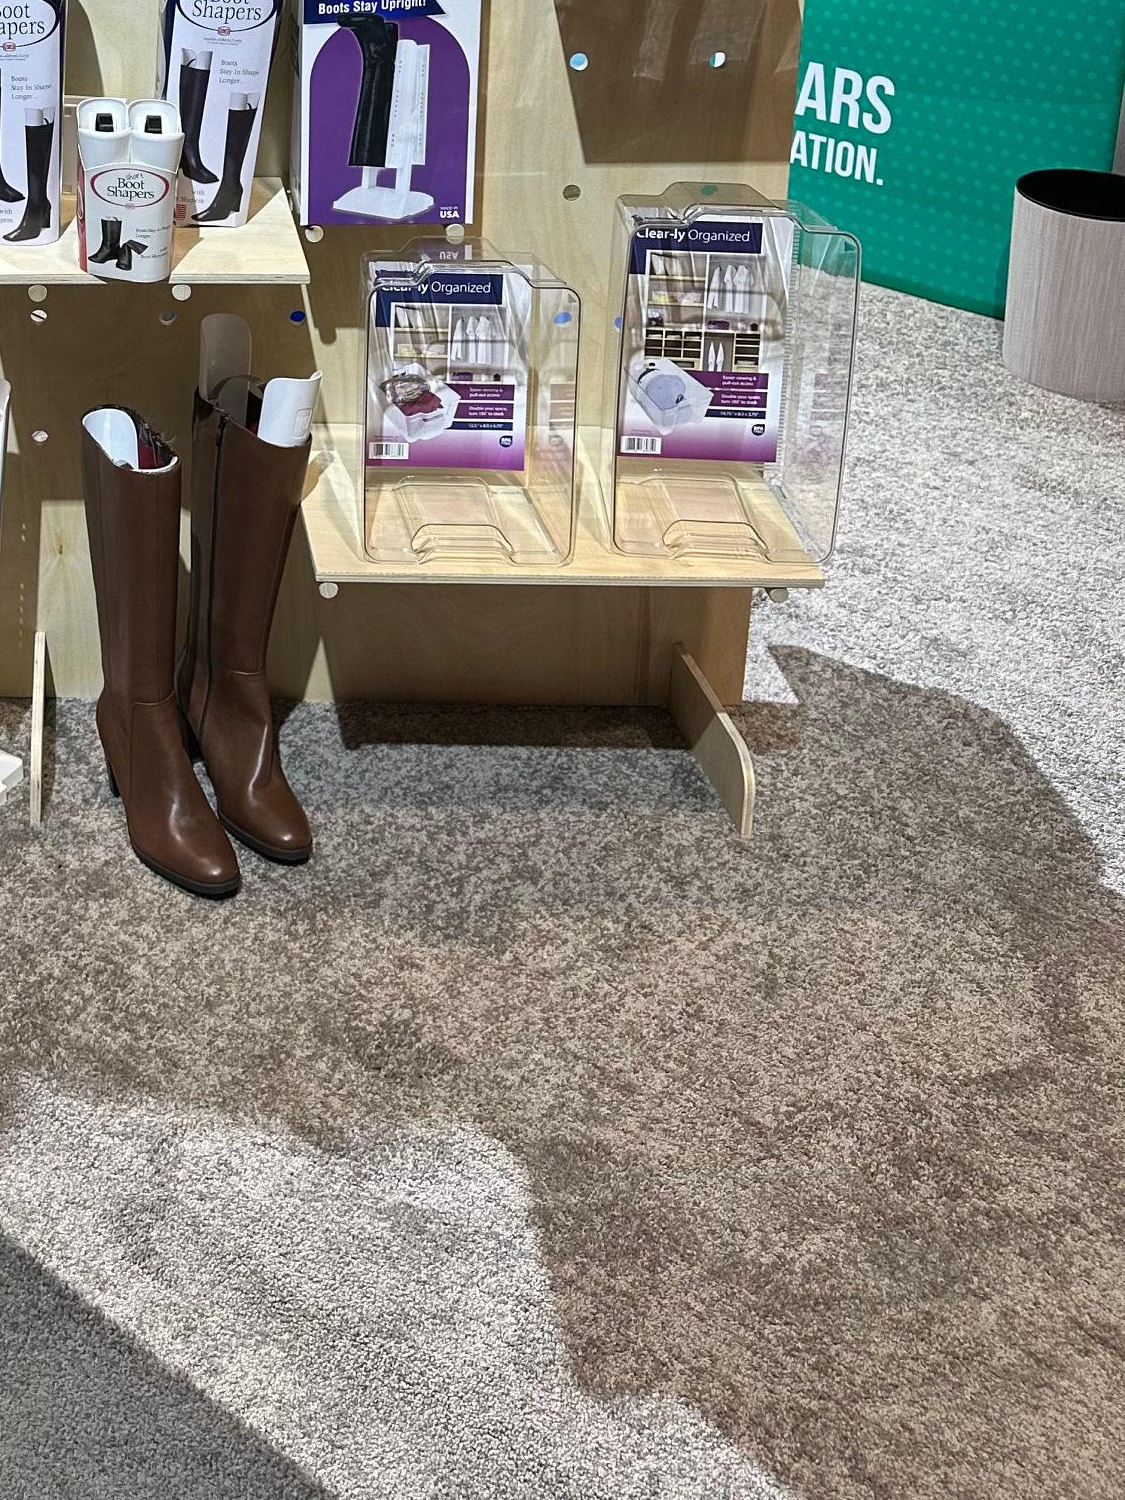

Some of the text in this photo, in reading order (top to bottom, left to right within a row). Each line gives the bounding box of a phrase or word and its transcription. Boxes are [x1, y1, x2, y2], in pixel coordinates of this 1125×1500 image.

[191, 0, 262, 24] Shapers
[318, 3, 350, 15] Boots
[353, 0, 378, 13] Stay
[117, 177, 145, 190] Boot
[107, 186, 154, 201] Shapers
[439, 210, 459, 219] USA
[688, 229, 750, 242] Organized
[431, 281, 491, 295] Organized
